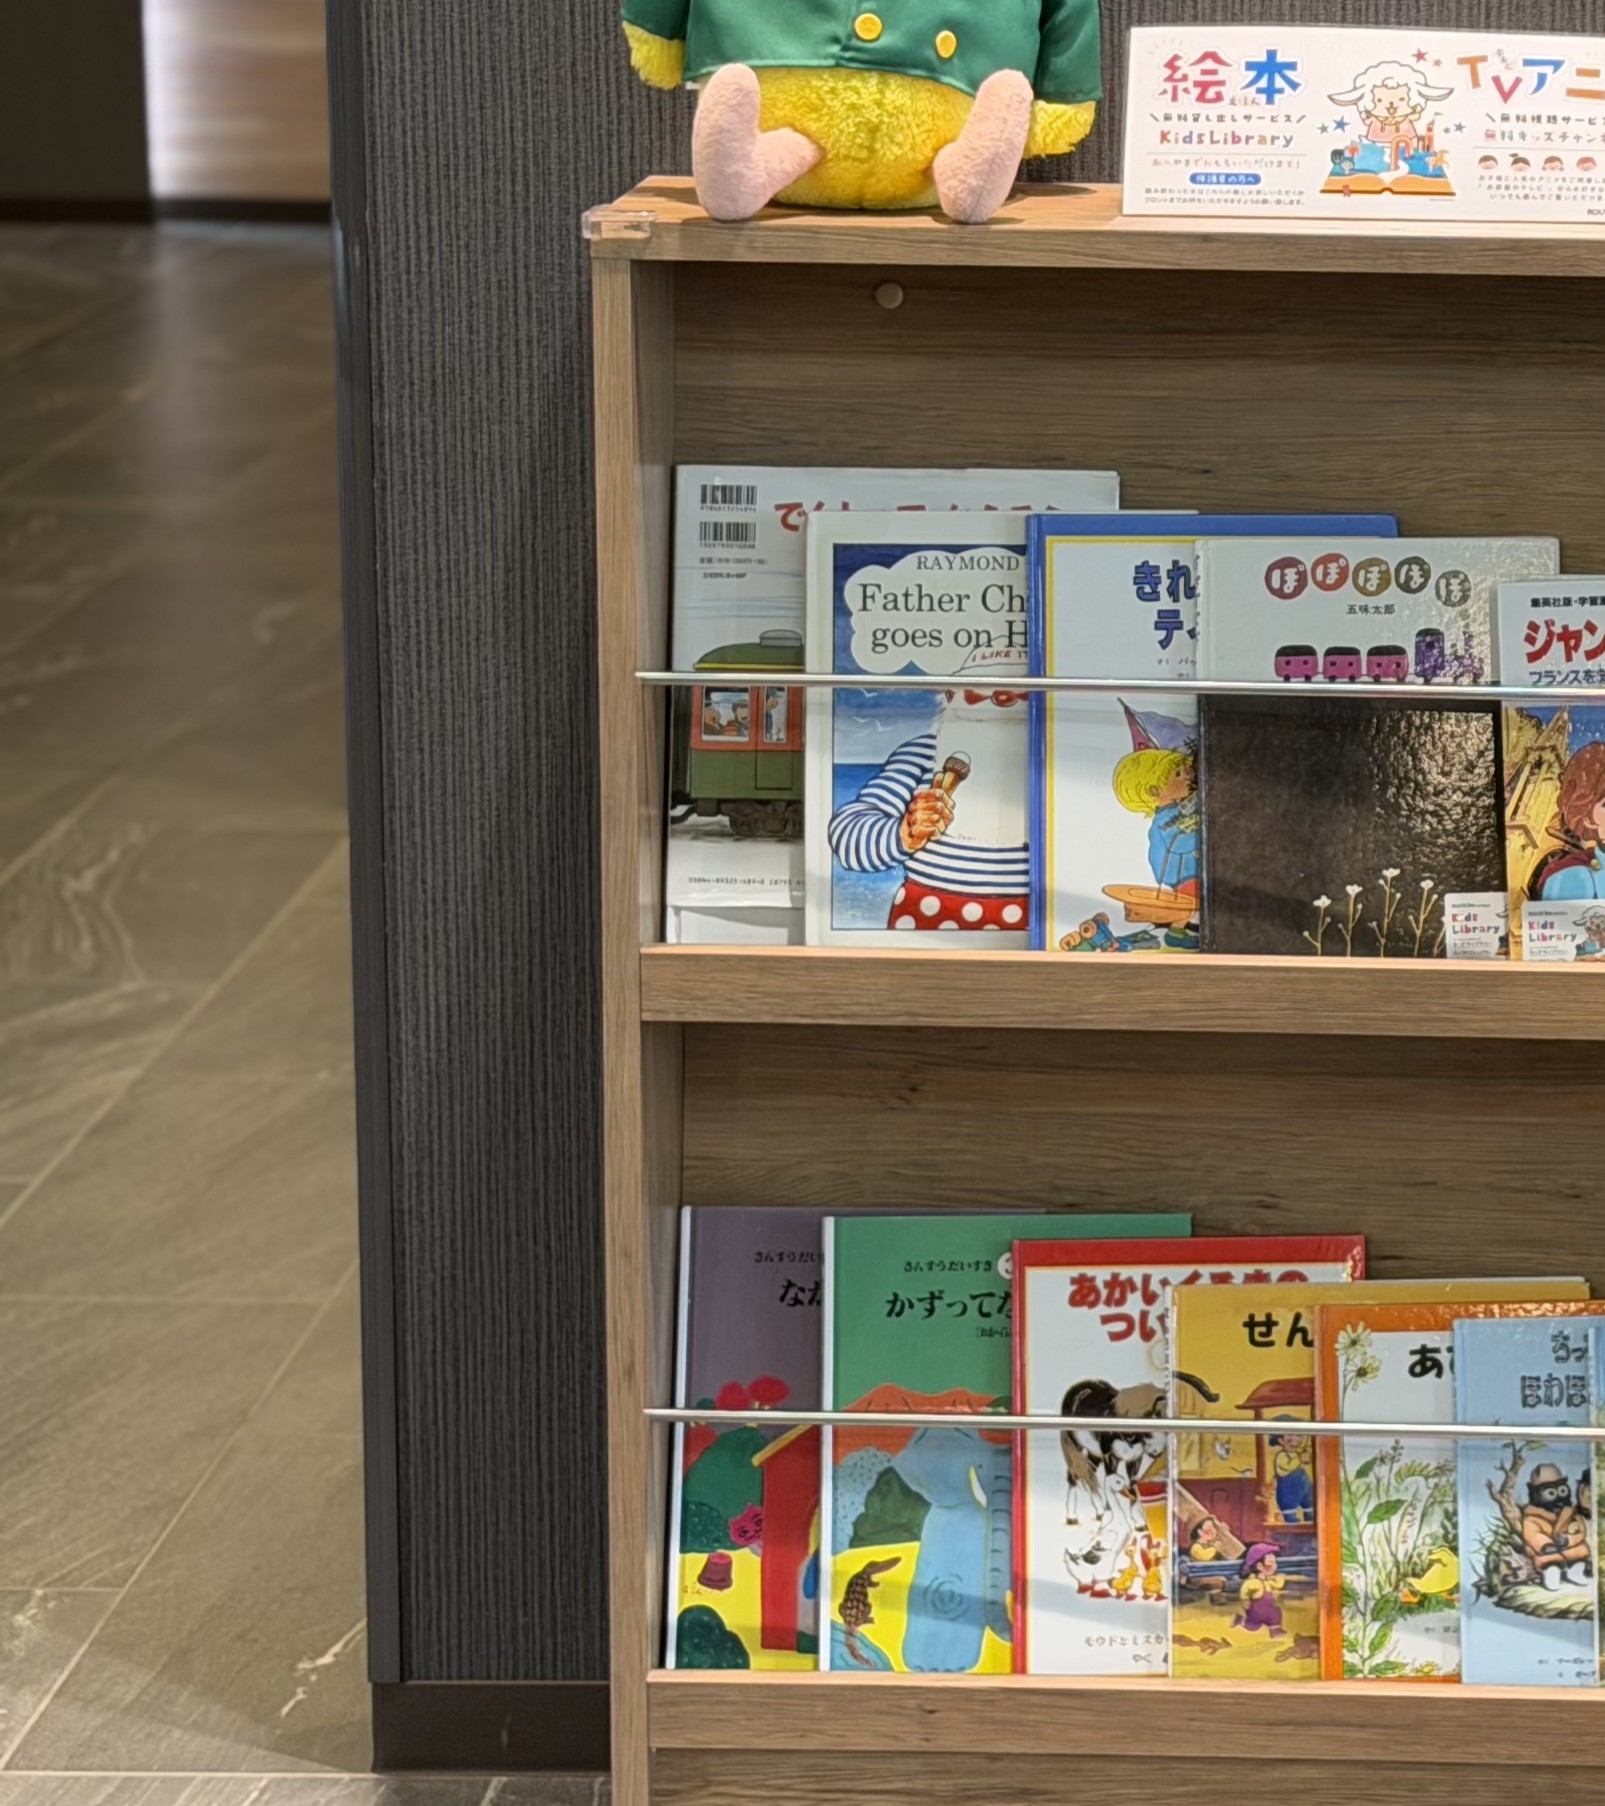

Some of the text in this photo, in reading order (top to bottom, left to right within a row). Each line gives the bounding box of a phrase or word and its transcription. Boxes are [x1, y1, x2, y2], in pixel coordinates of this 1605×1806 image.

[1157, 49, 1303, 106] 絵本
[916, 555, 1020, 571] RAYMOND
[857, 583, 971, 613] Father
[1346, 604, 1396, 615] 五味太郎
[871, 627, 943, 654] goes
[953, 627, 993, 649] on
[981, 650, 1012, 661] LIKE
[1451, 912, 1479, 922] Kds
[1452, 924, 1501, 935] Library
[1528, 931, 1577, 943] Library
[754, 1251, 824, 1264] さんすうだい
[903, 1259, 993, 1273] さんすうだいすき
[1242, 1311, 1314, 1348] せん
[1407, 1343, 1455, 1380] あ
